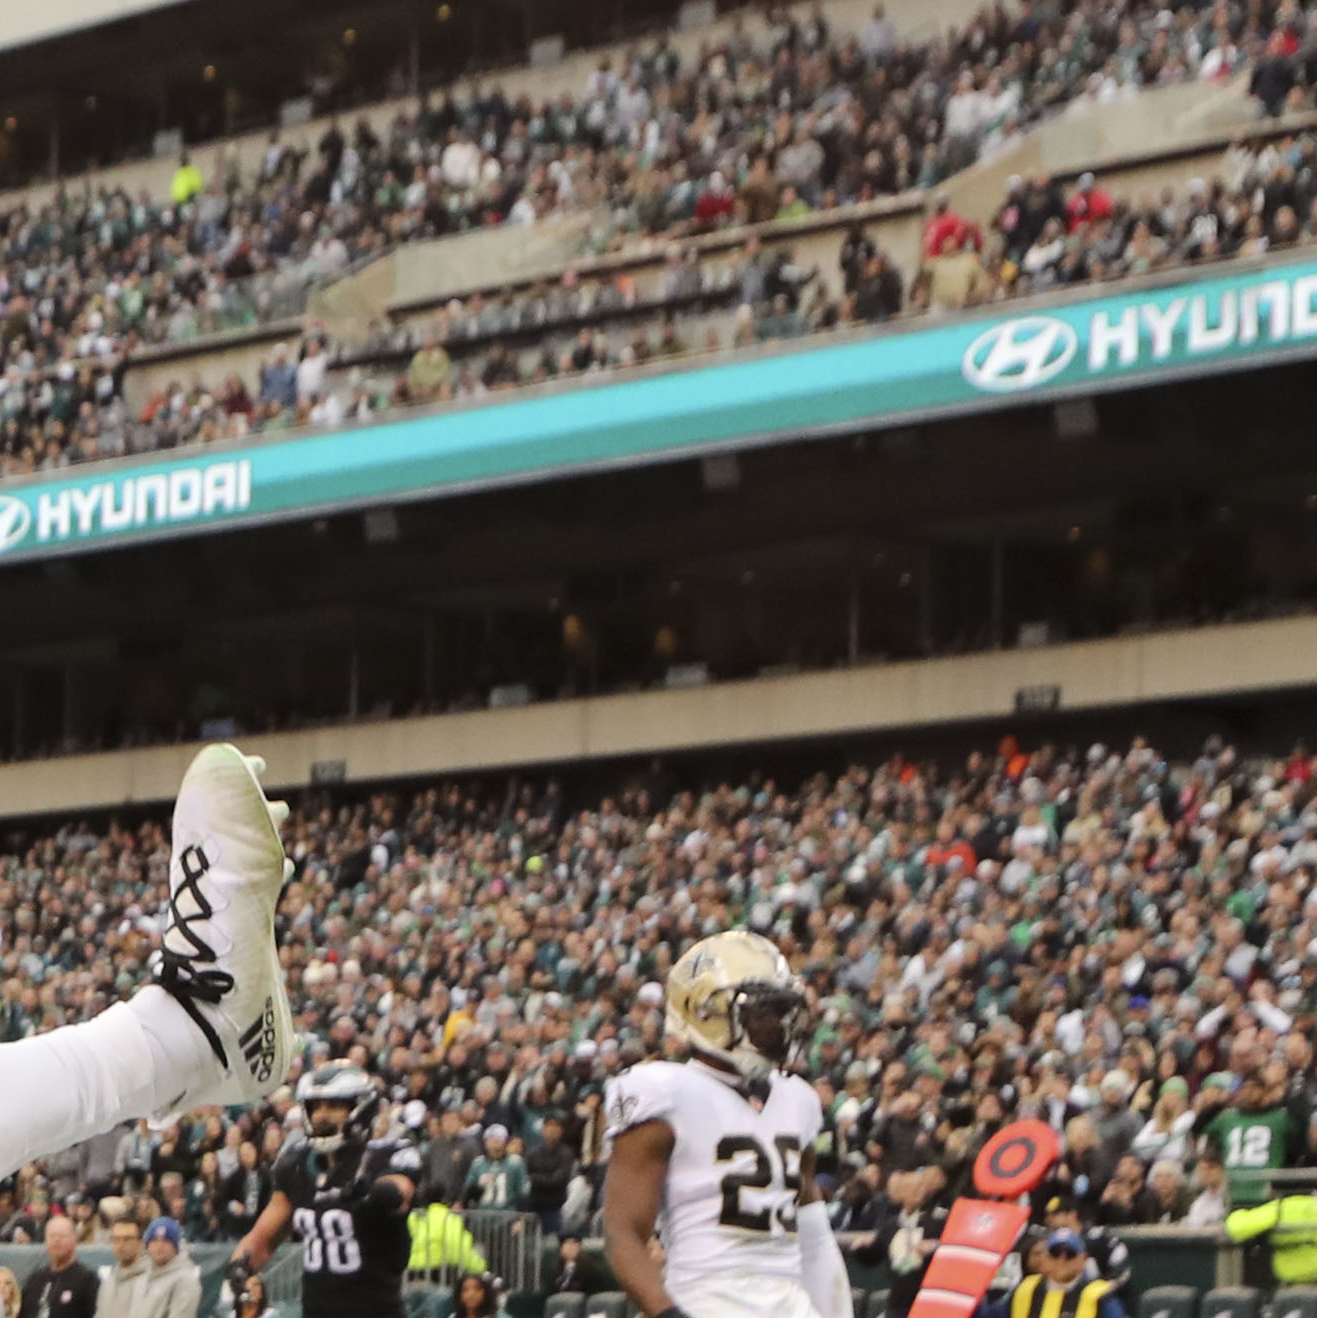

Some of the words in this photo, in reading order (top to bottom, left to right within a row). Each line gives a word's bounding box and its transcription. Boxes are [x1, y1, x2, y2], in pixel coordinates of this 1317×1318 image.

[36, 459, 253, 541] HYUNDAI
[257, 995, 276, 1082] adidas
[1225, 1125, 1271, 1169] 12
